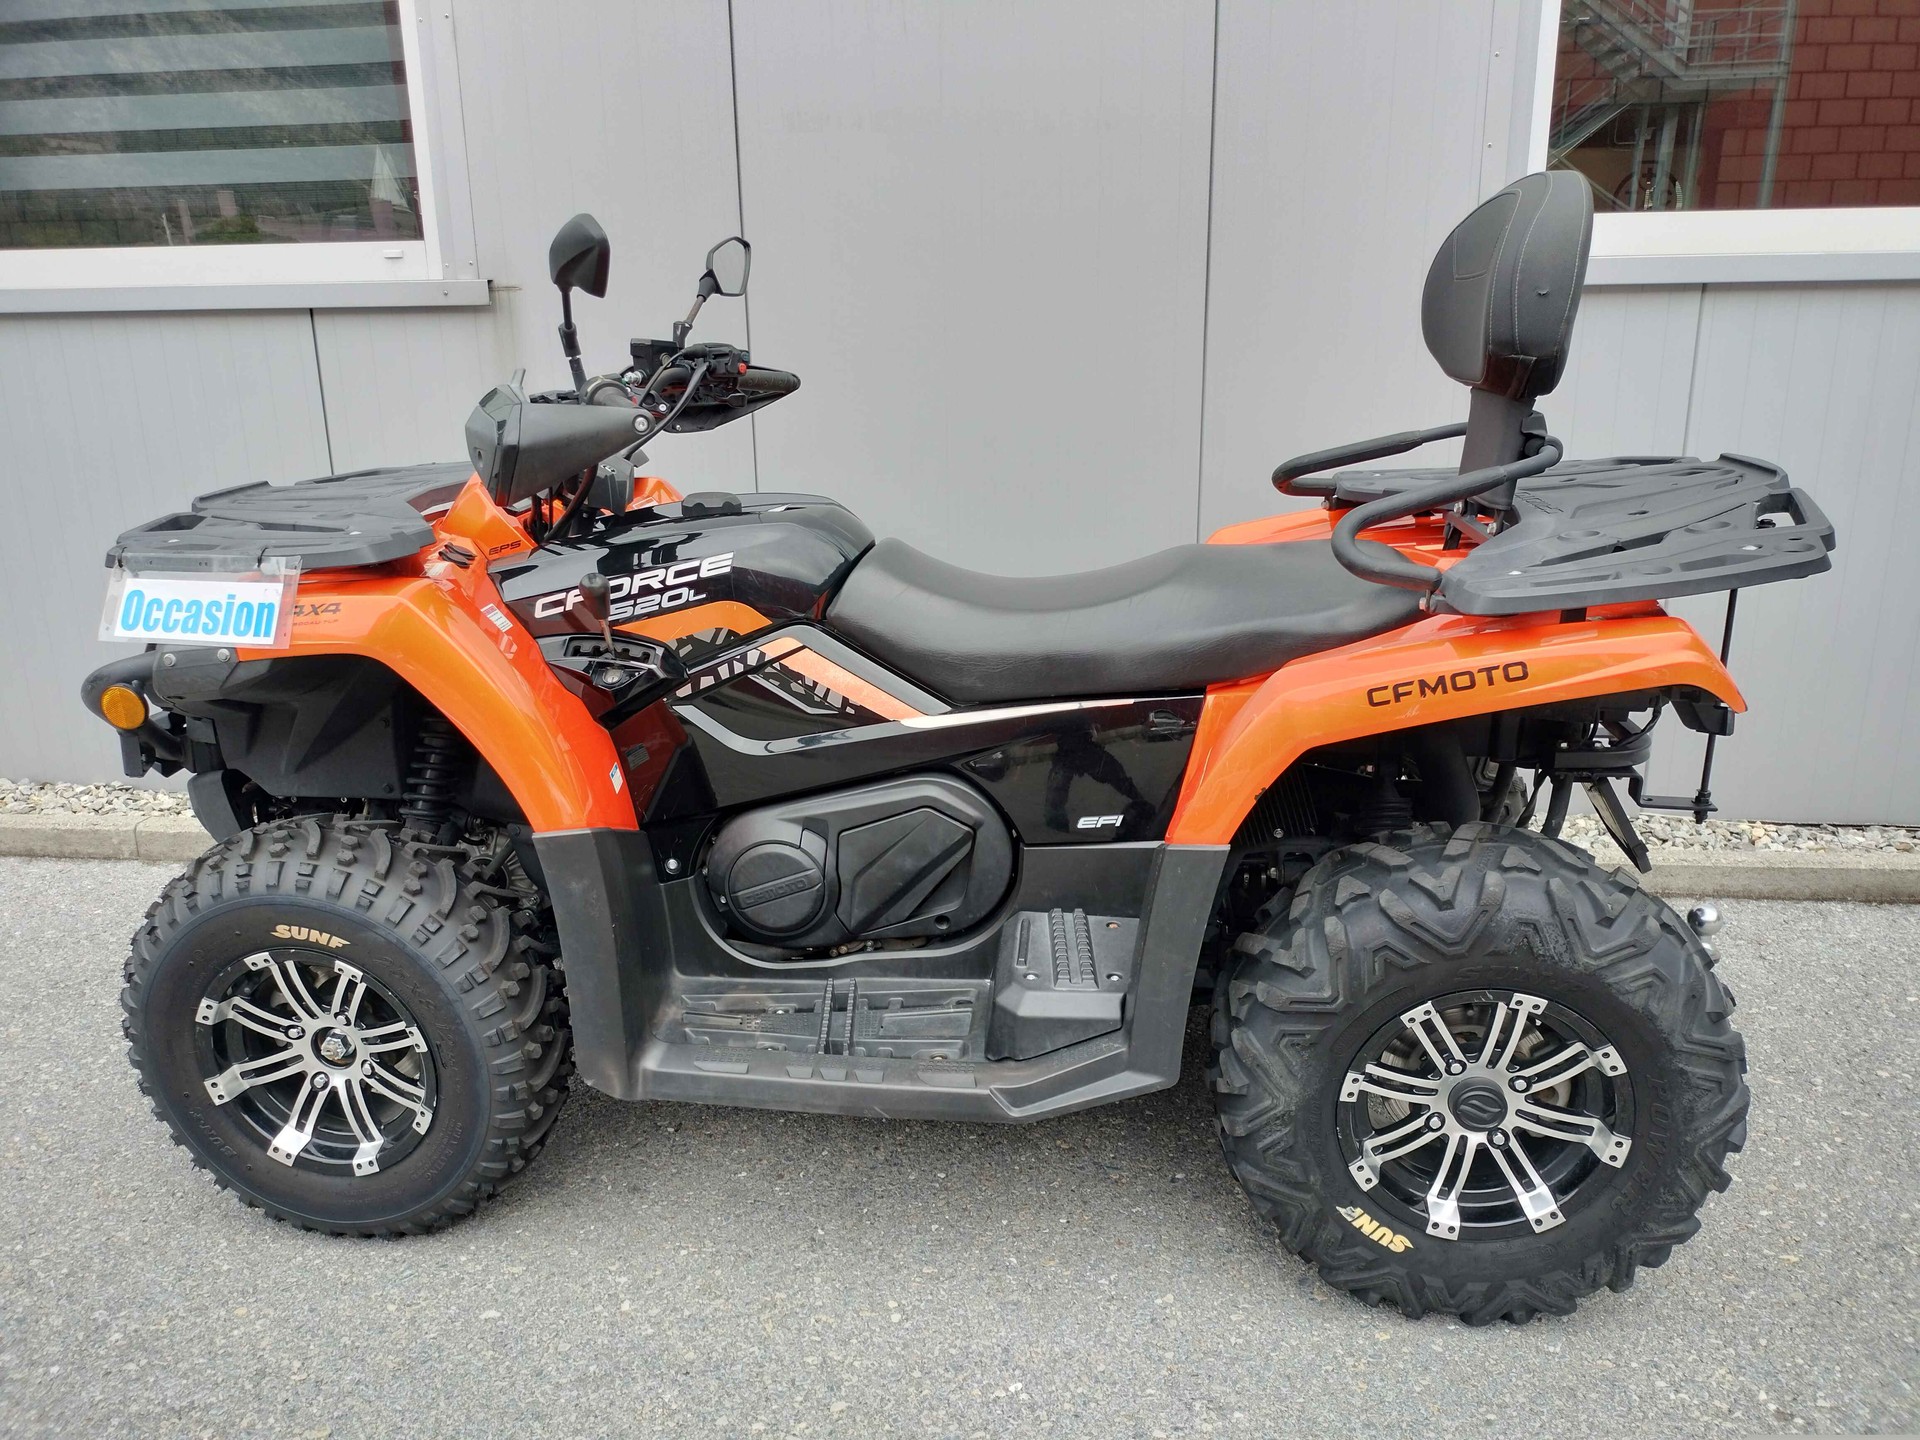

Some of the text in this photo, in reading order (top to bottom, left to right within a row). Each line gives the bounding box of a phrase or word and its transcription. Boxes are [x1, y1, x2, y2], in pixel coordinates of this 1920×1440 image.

[489, 539, 521, 555] EPS
[119, 589, 276, 638] Occasion
[1366, 660, 1529, 708] CFMOTO
[1077, 814, 1124, 829] EFI
[270, 924, 352, 949] SUNF
[1336, 1205, 1414, 1253] SUNF
